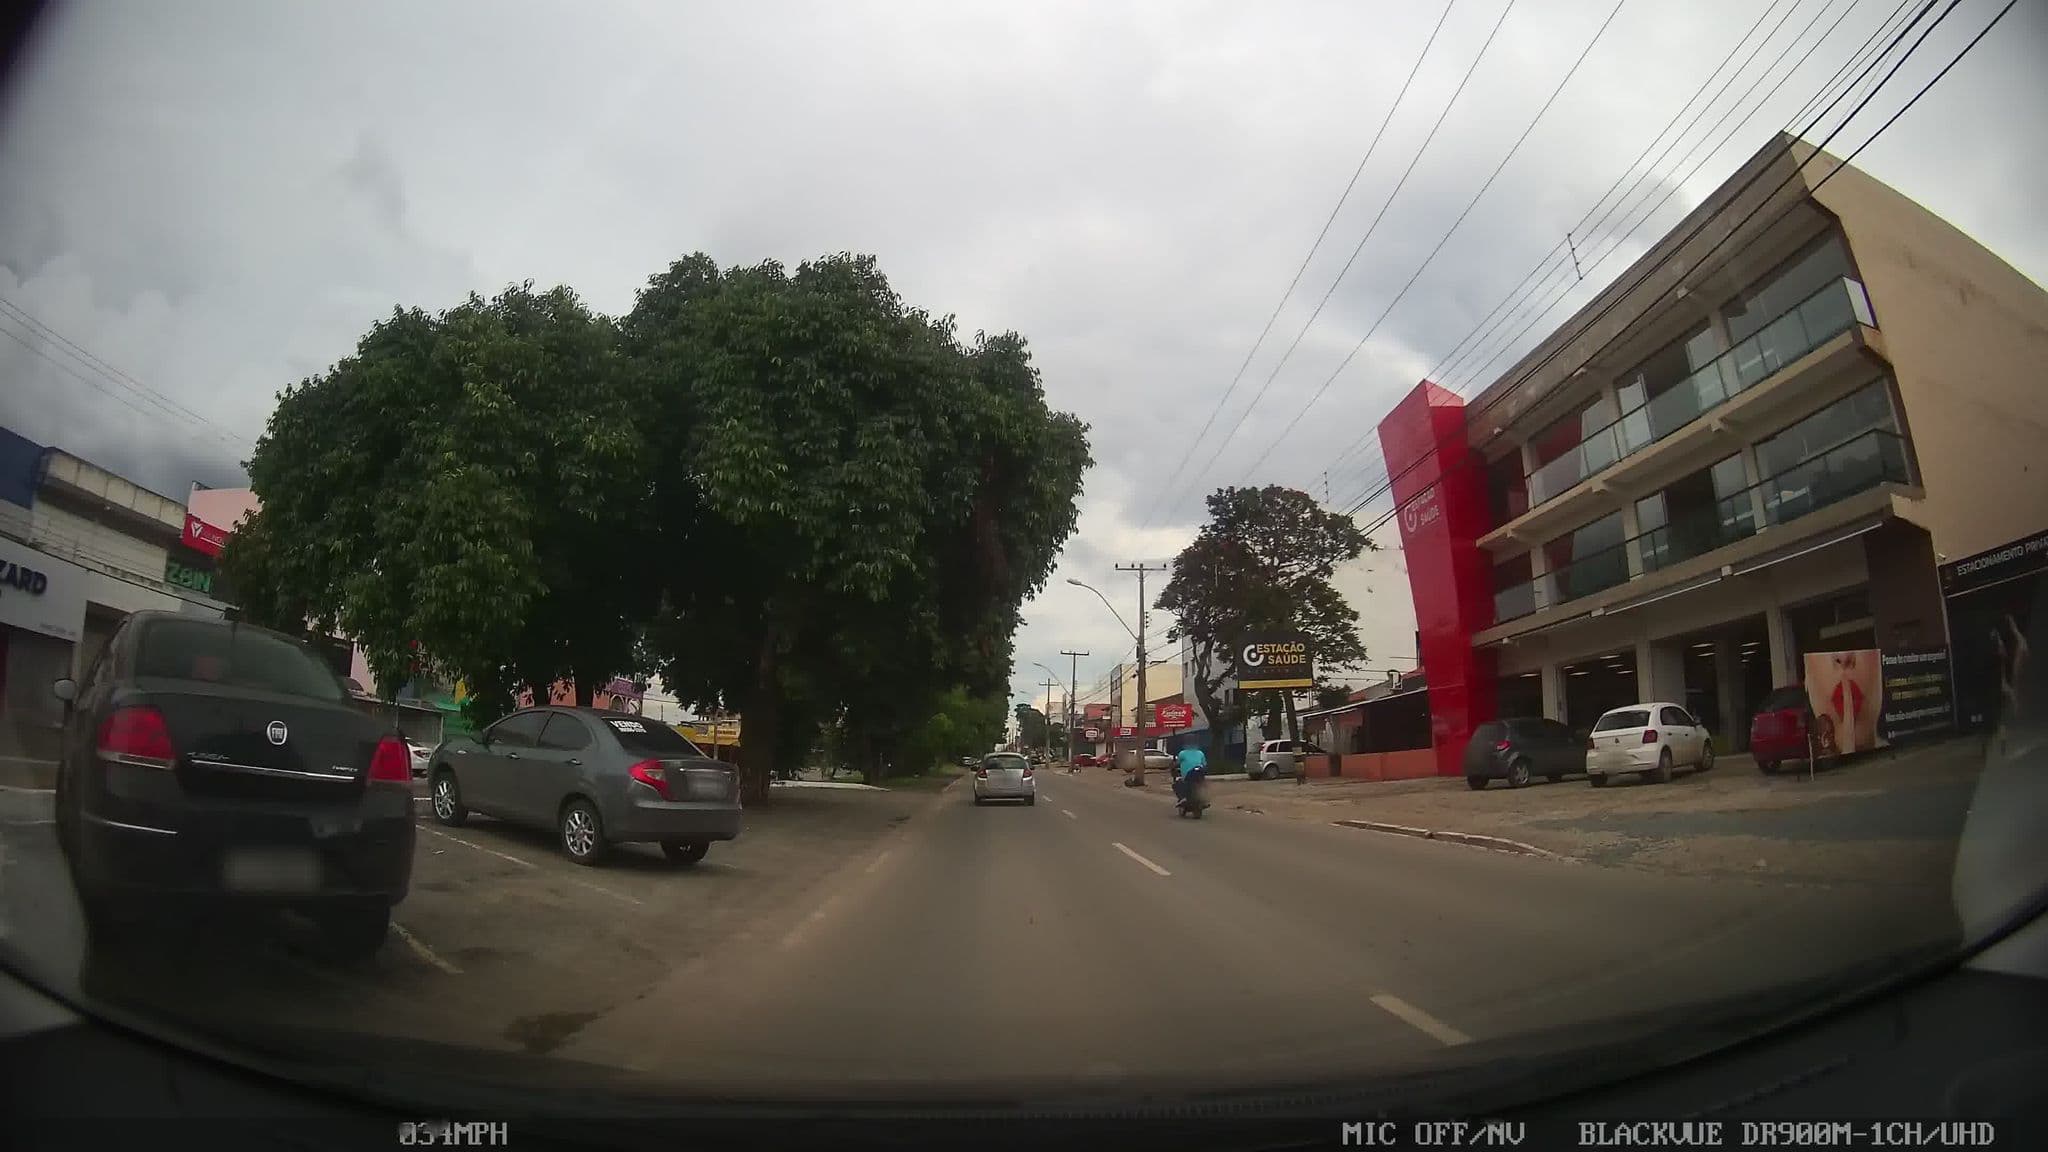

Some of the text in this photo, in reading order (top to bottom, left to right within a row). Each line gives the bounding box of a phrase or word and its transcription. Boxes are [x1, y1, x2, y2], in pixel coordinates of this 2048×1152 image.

[1256, 641, 1305, 654] ESTAÇÃO
[1267, 653, 1307, 665] SAÚDE
[610, 720, 643, 729] VENDO
